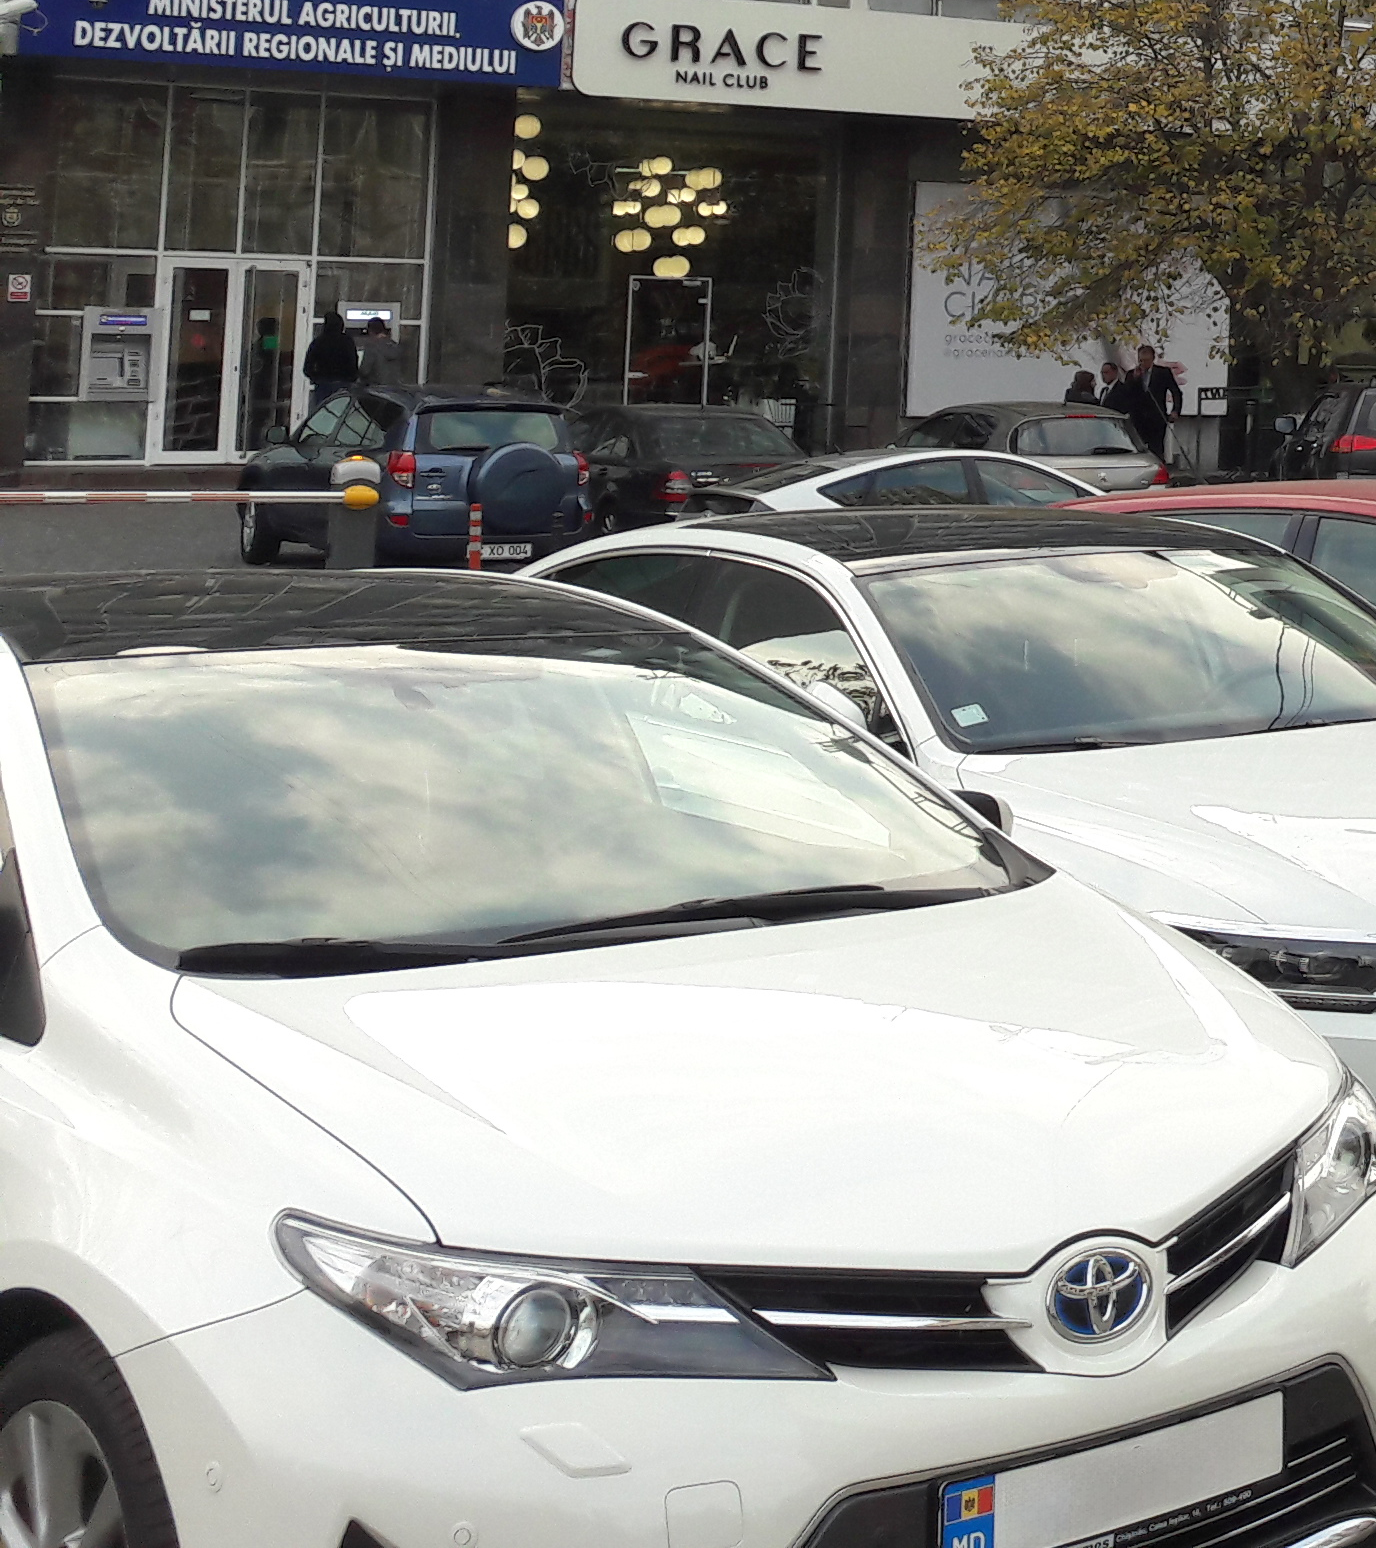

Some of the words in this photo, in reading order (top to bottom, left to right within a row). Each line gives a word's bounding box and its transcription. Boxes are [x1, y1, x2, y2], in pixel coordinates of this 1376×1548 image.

[297, 1, 462, 39] AGRICULTURII,
[73, 19, 236, 56] DEZVOLTĂRII
[242, 32, 377, 66] REGIONALE
[409, 44, 518, 75] MEDIULUI
[622, 21, 823, 72] GRACE
[675, 69, 717, 87] NAIL
[722, 73, 769, 89] CLUB
[509, 545, 528, 556] 004
